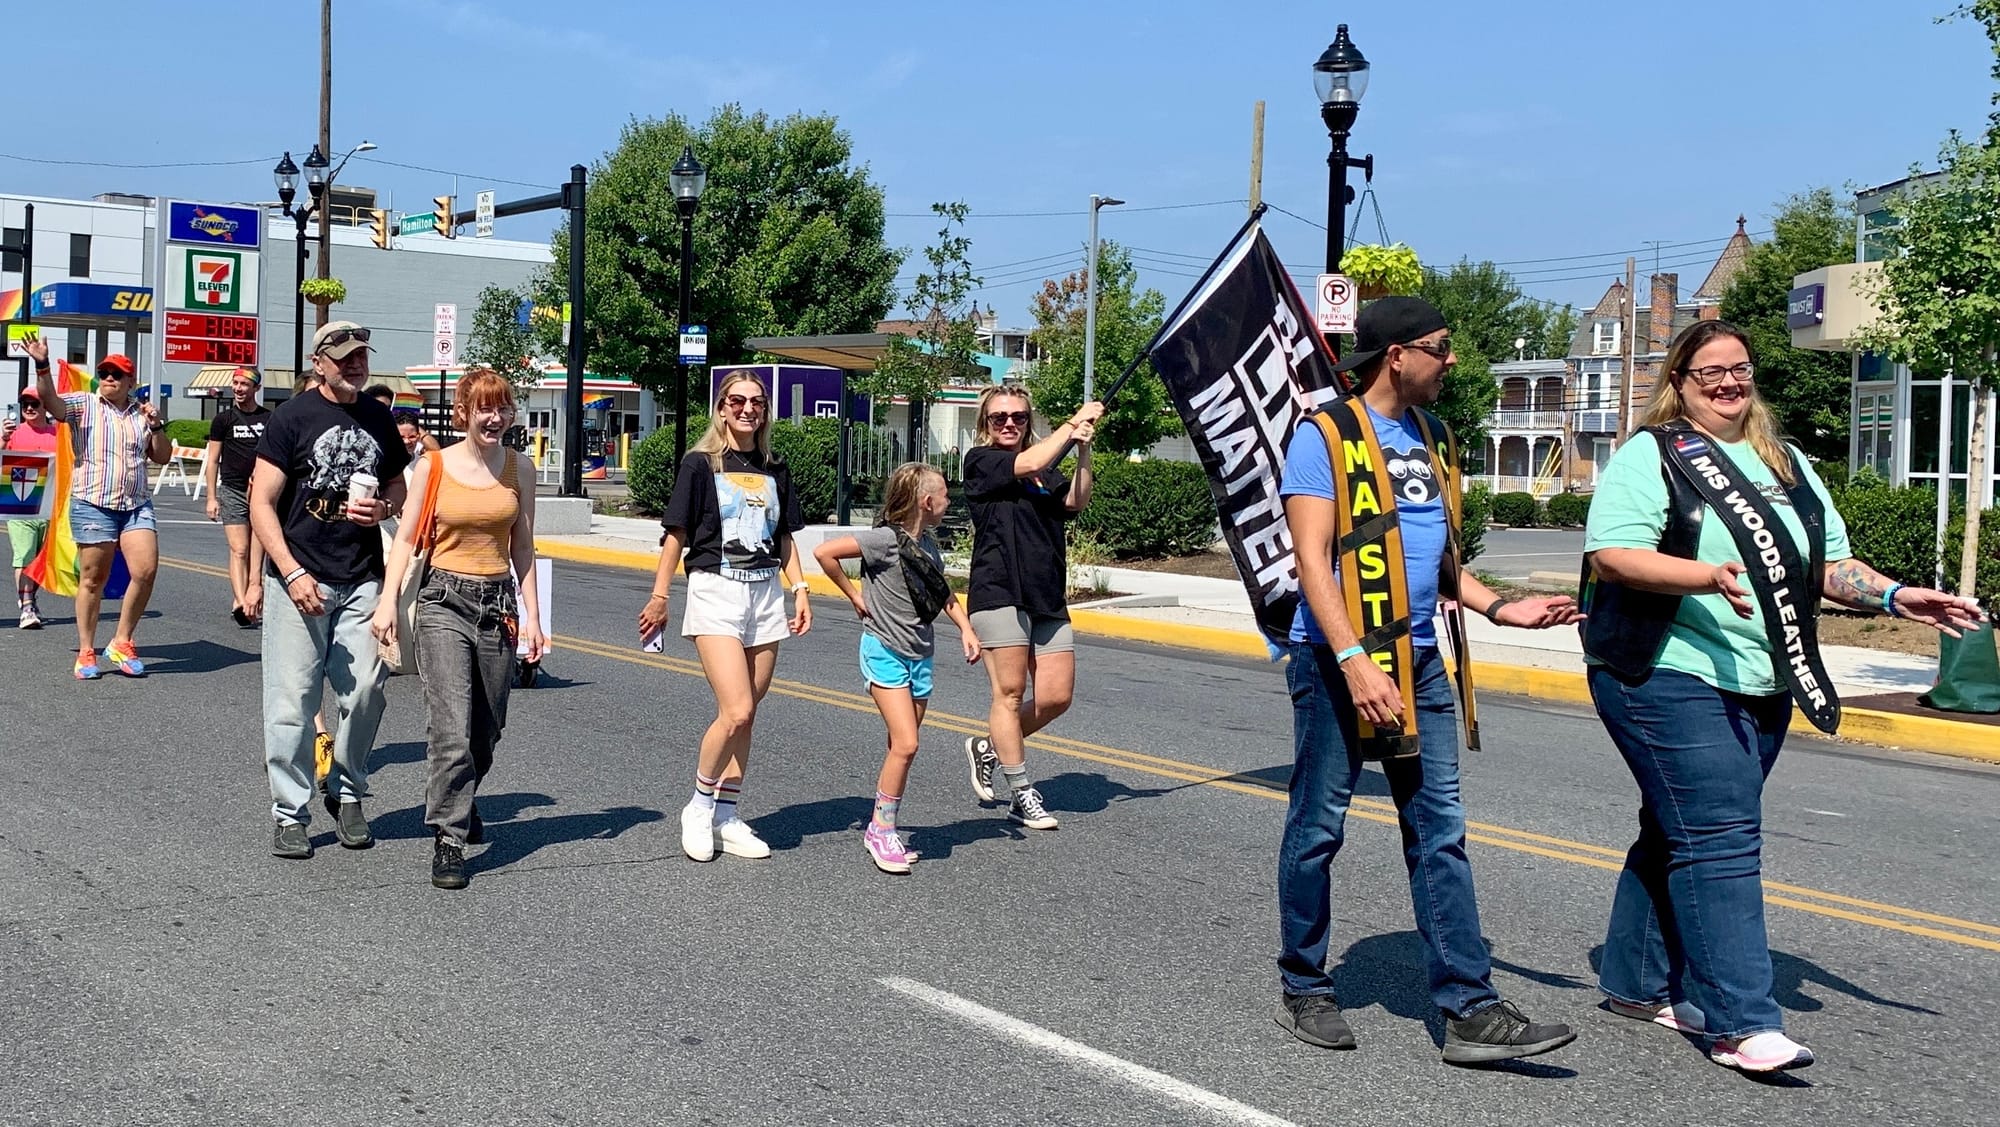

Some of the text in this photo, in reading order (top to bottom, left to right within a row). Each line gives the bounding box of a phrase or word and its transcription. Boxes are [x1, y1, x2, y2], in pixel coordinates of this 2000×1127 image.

[192, 219, 238, 232] SUNOCO
[402, 218, 434, 233] Hamilton
[199, 262, 230, 305] 7
[111, 291, 153, 312] SU
[167, 317, 190, 327] Regular
[1320, 313, 1352, 321] PARKING
[1188, 371, 1299, 606] MATTER
[306, 498, 348, 522] QUE
[1343, 440, 1393, 673] MASTE
[1691, 455, 1731, 490] MS
[1724, 489, 1786, 584] WOODS
[1773, 587, 1828, 711] LEATHER
